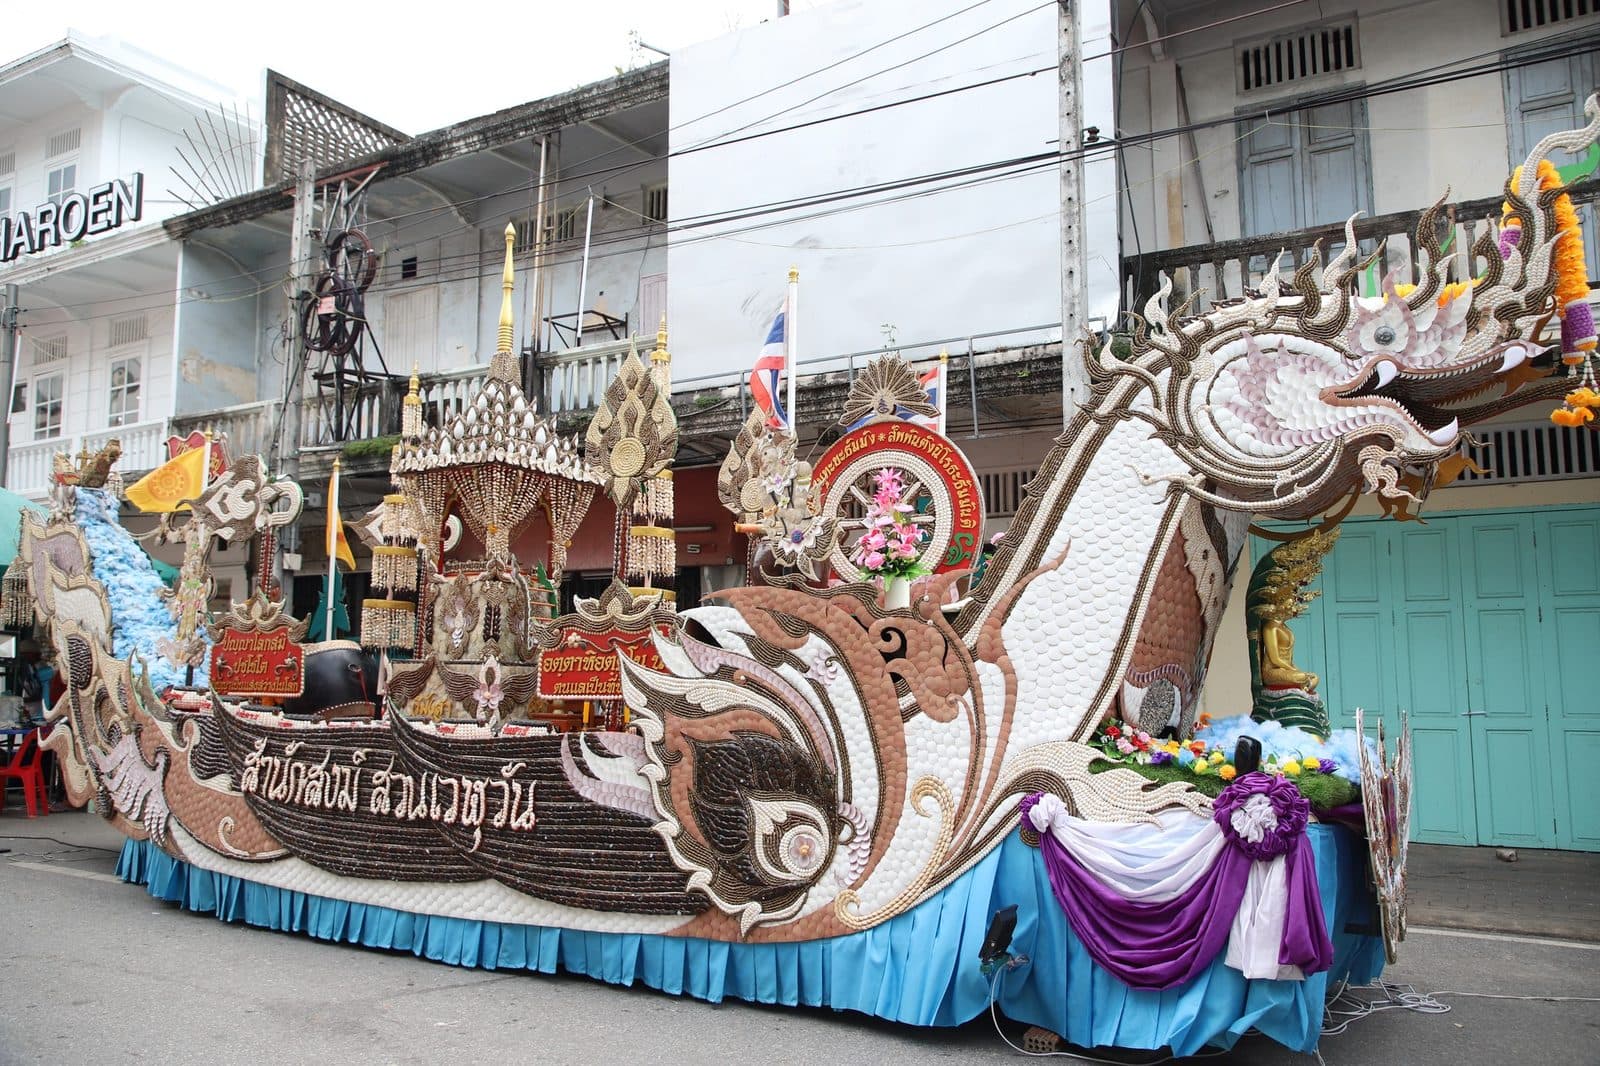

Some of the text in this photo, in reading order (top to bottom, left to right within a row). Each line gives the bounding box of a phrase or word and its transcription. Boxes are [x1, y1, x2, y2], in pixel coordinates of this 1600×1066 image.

[240, 737, 538, 853] สำนักสงฆ์ สวนเวฬุวัน
